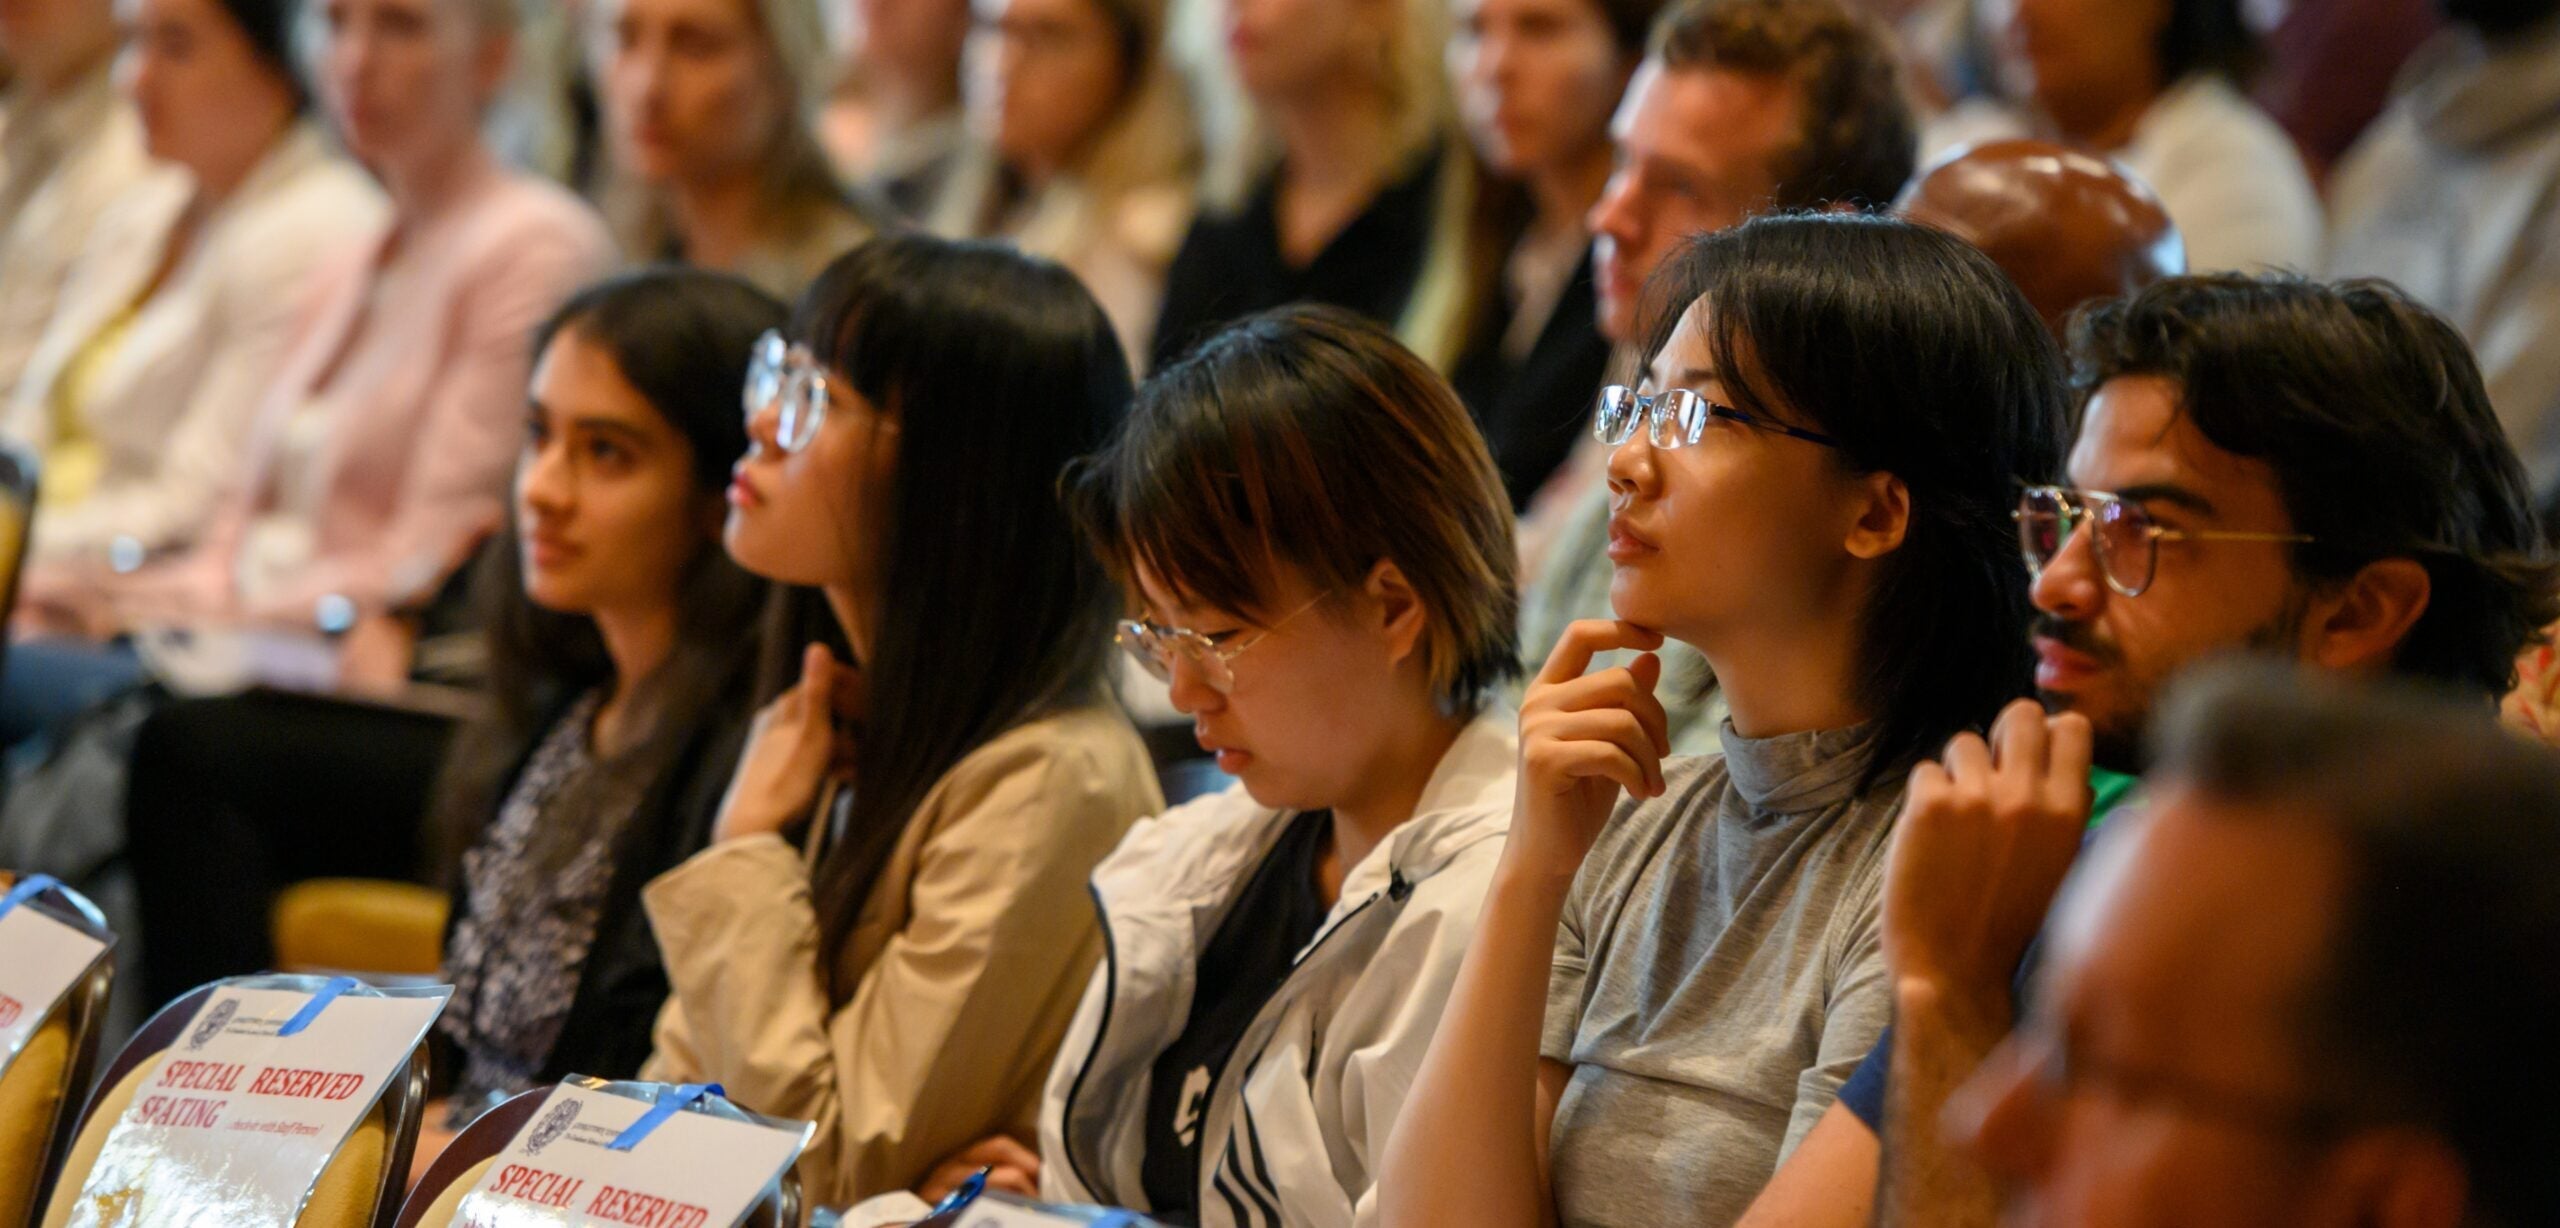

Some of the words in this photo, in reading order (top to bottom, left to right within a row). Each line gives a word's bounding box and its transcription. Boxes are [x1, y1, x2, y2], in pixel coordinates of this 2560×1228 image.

[157, 1060, 245, 1092] SPECIAL
[248, 1067, 364, 1100] RESERVED
[133, 1095, 227, 1128] SEATING
[489, 1164, 583, 1209] SPECIAL
